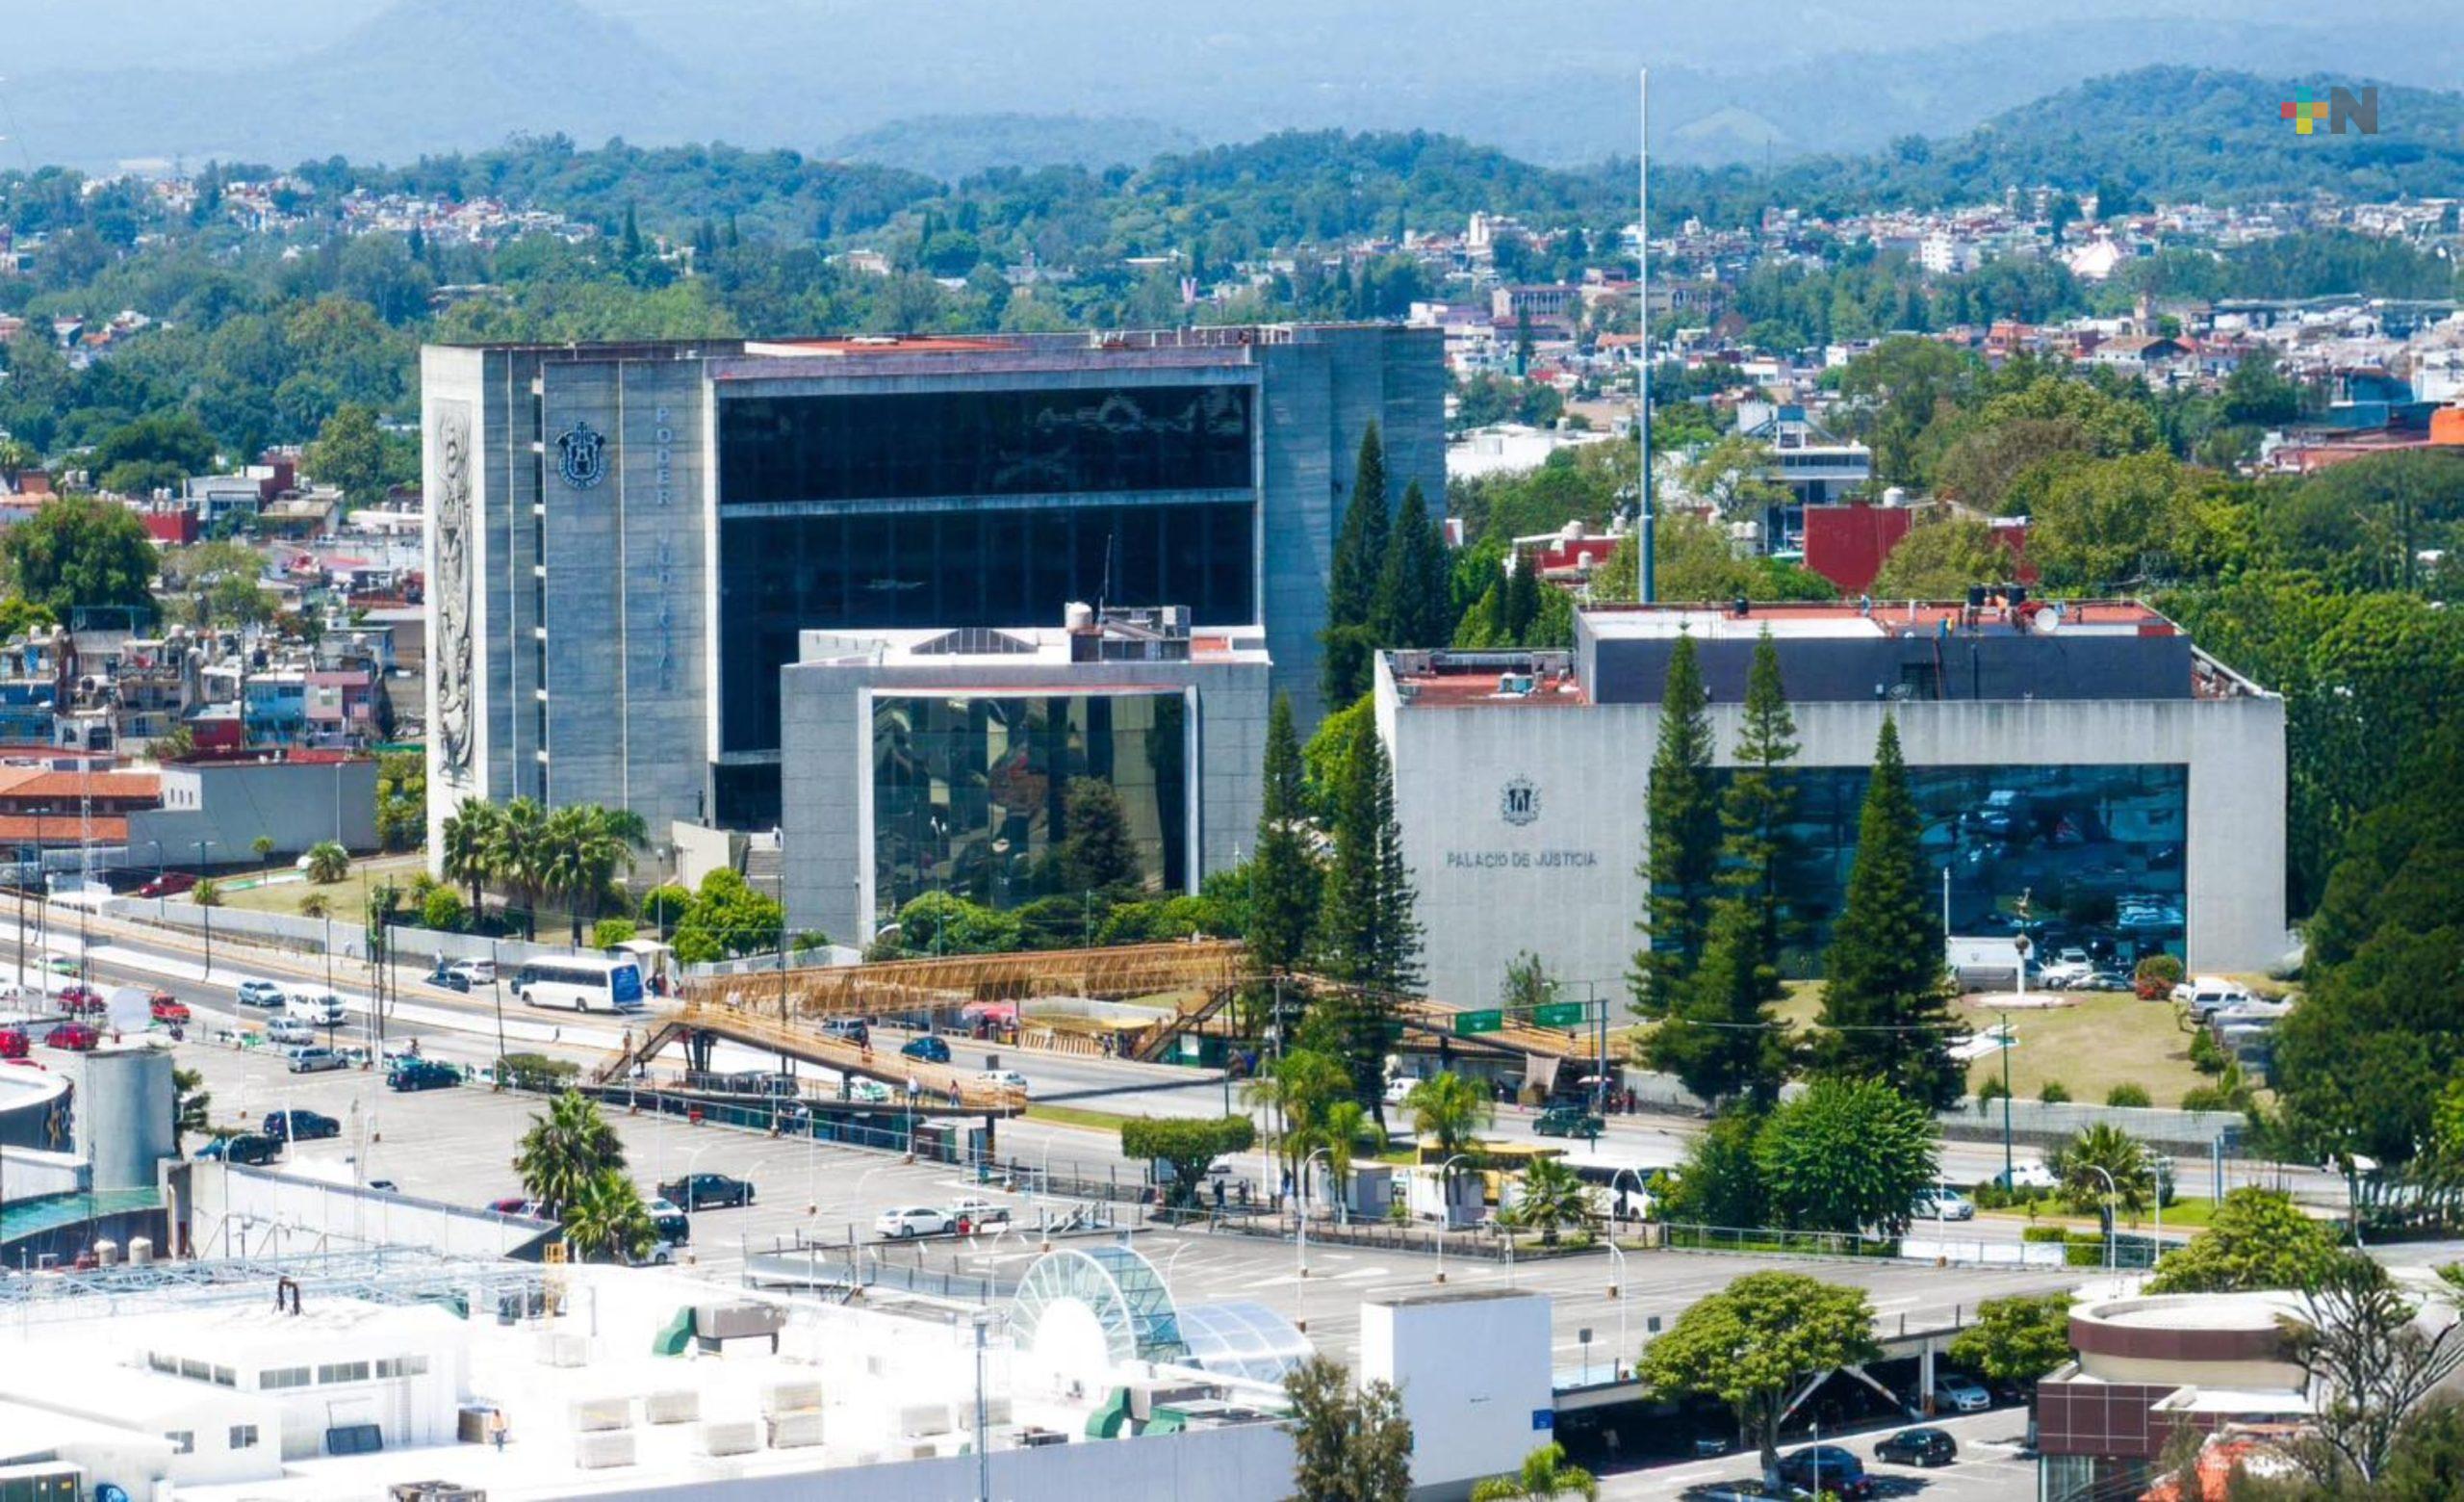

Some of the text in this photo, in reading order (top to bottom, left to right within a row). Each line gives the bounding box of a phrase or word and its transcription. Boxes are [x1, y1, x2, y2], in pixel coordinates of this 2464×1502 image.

[655, 406, 672, 505] PODER
[1446, 850, 1598, 868] PALACIO DE JUSTICIA
